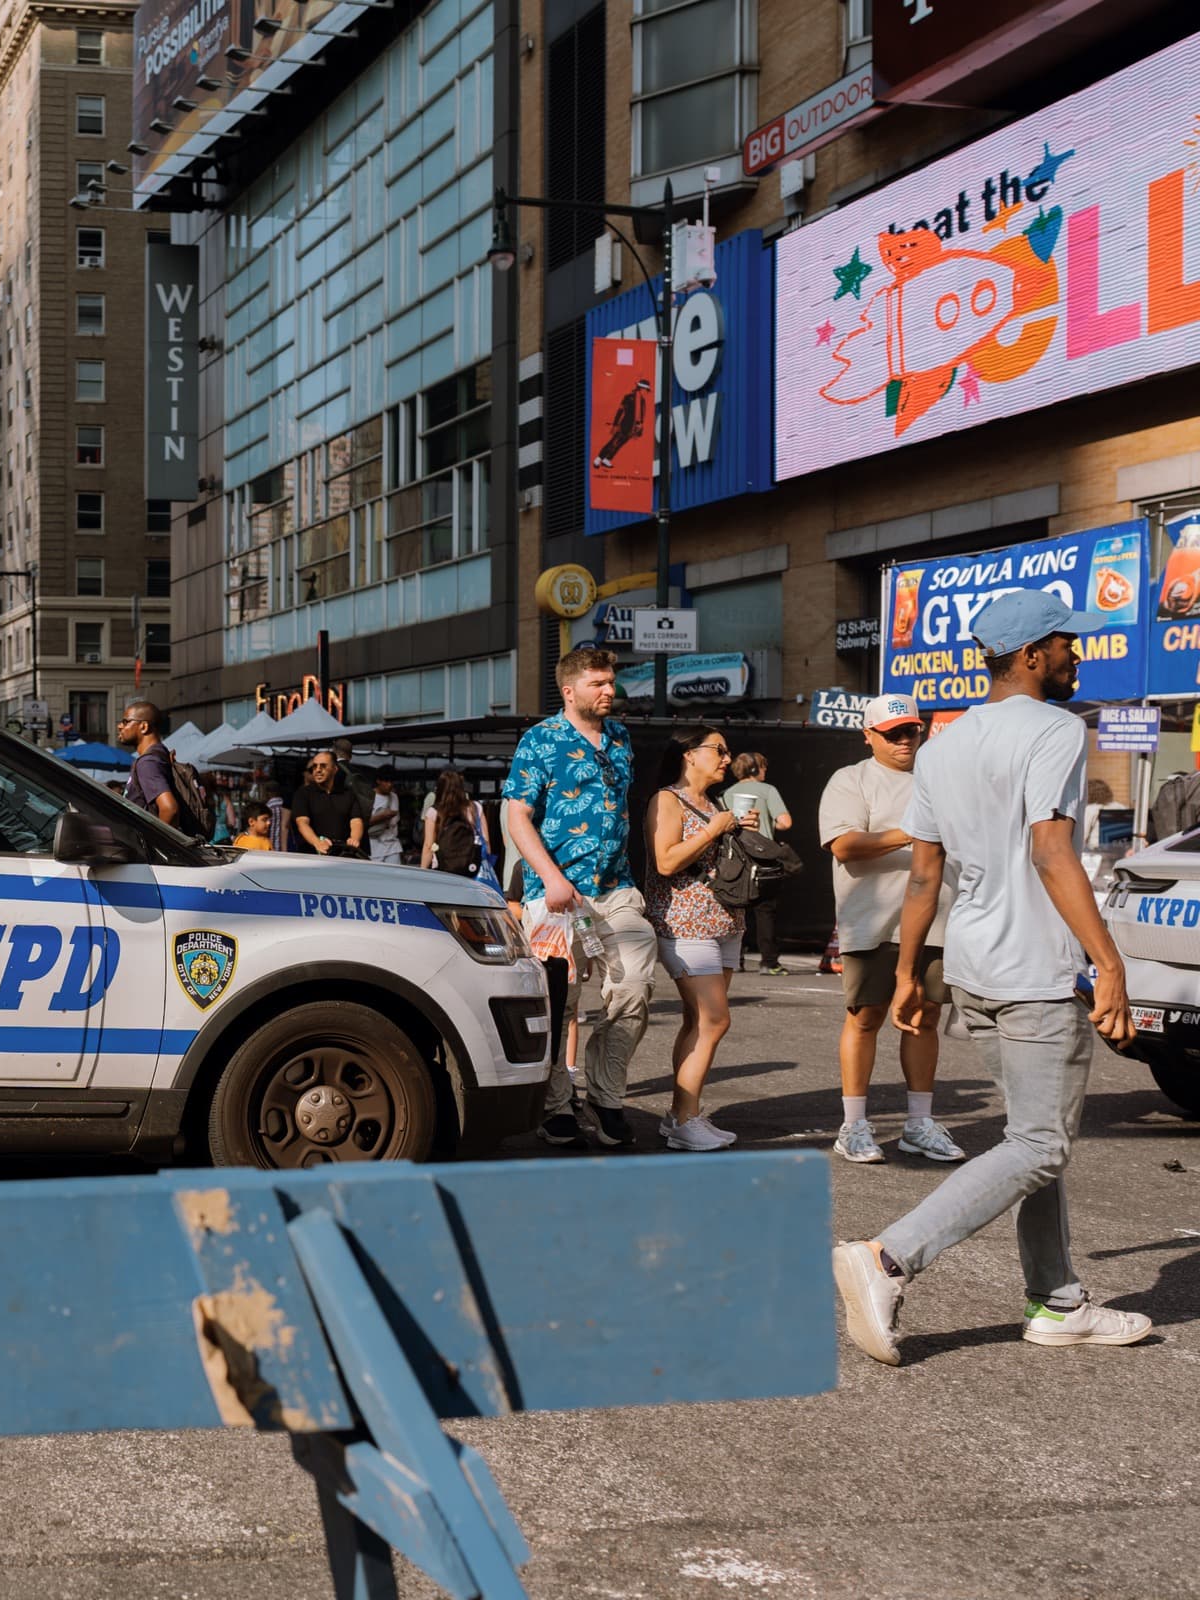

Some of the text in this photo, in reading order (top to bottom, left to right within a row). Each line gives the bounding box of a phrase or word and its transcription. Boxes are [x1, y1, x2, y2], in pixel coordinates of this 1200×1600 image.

[749, 126, 780, 168] BIG
[155, 283, 194, 462] WESTIN
[928, 545, 1079, 591] SOUVLA KING
[606, 623, 634, 641] An
[657, 632, 688, 640] CORRIDOR
[837, 623, 847, 636] 42
[639, 641, 692, 649] PHOTO ENFORCED
[836, 636, 869, 649] Subway
[891, 633, 1128, 677] CHICKEN, BE AMB
[673, 681, 727, 696] CINNABON
[912, 676, 989, 701] ICE COLD
[816, 709, 864, 730] GYR
[1101, 709, 1158, 723] RICE & SALAD
[302, 893, 398, 924] POLICE
[1136, 896, 1200, 928] NYPD
[188, 932, 223, 944] POLICE
[176, 941, 234, 957] DEPARTMENT
[177, 960, 234, 1001] CITY OF NEW YORK
